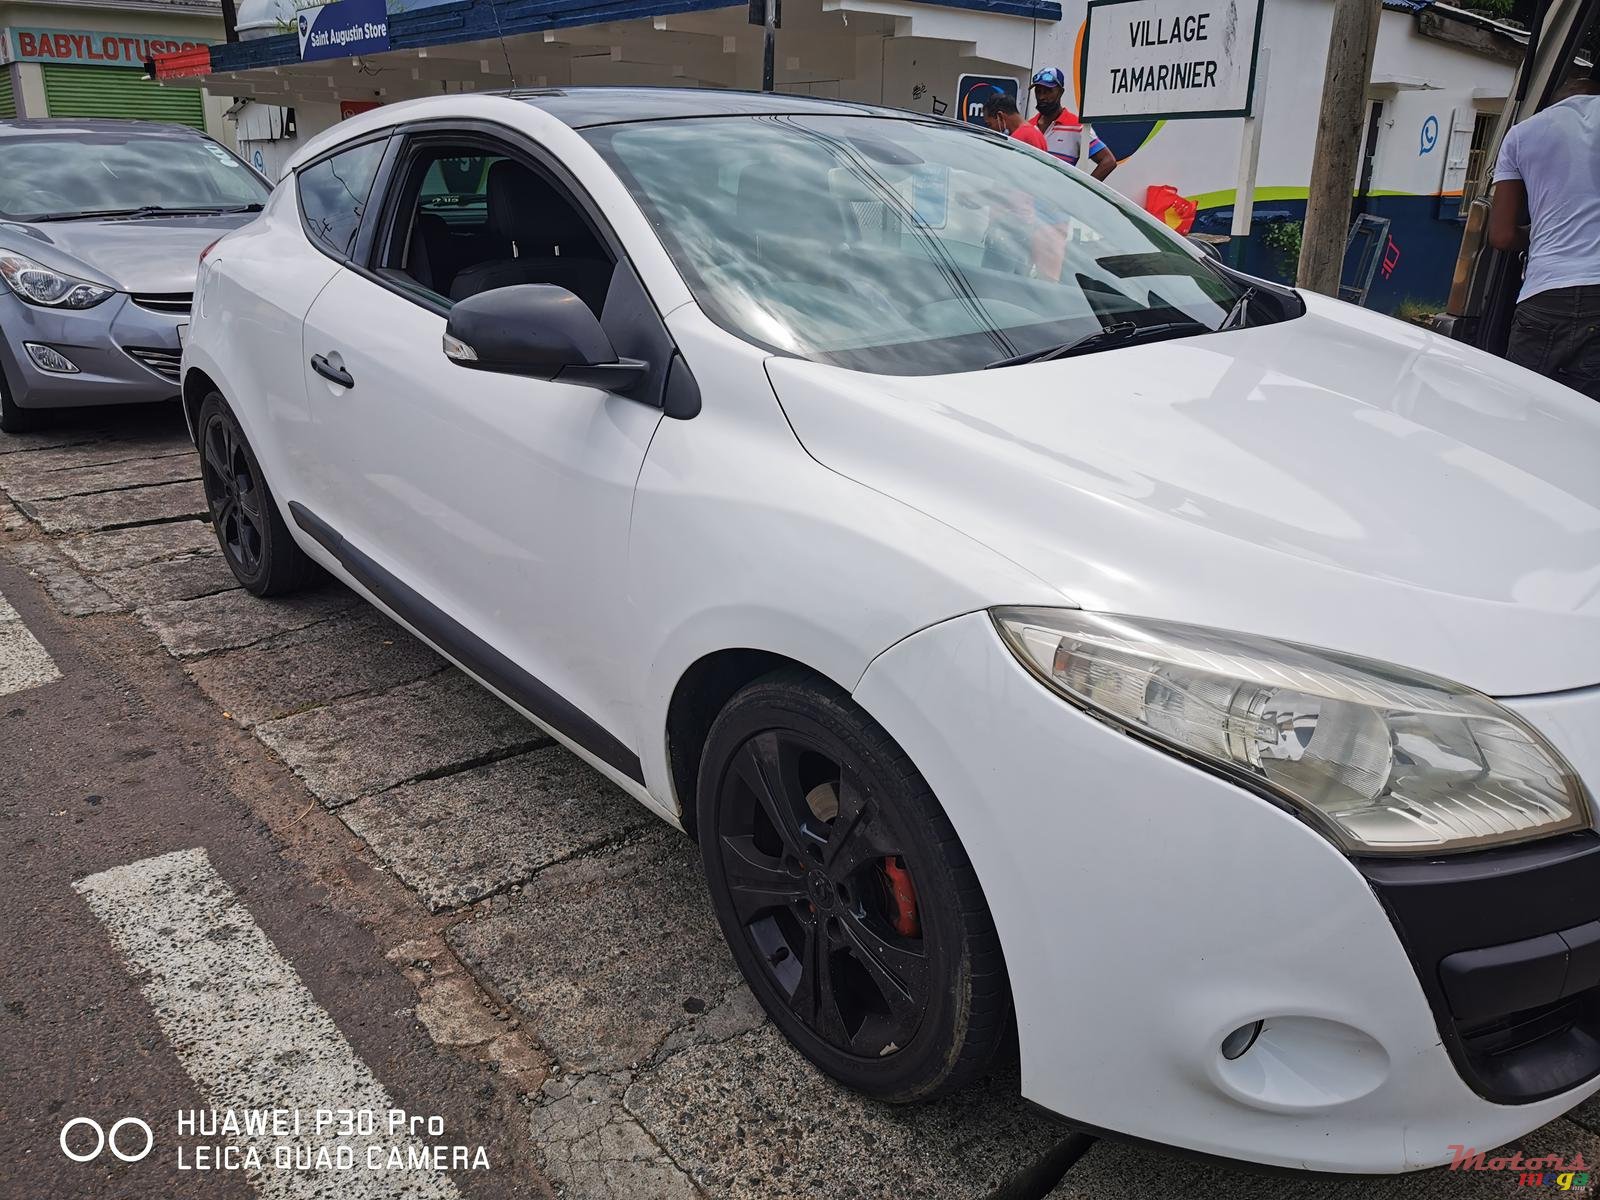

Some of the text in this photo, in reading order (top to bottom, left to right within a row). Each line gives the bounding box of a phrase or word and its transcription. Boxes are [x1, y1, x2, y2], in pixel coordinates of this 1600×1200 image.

[311, 23, 387, 47] Saint Augustin Store
[1129, 13, 1210, 48] VILLAGE
[1110, 60, 1217, 94] TAMARINIER
